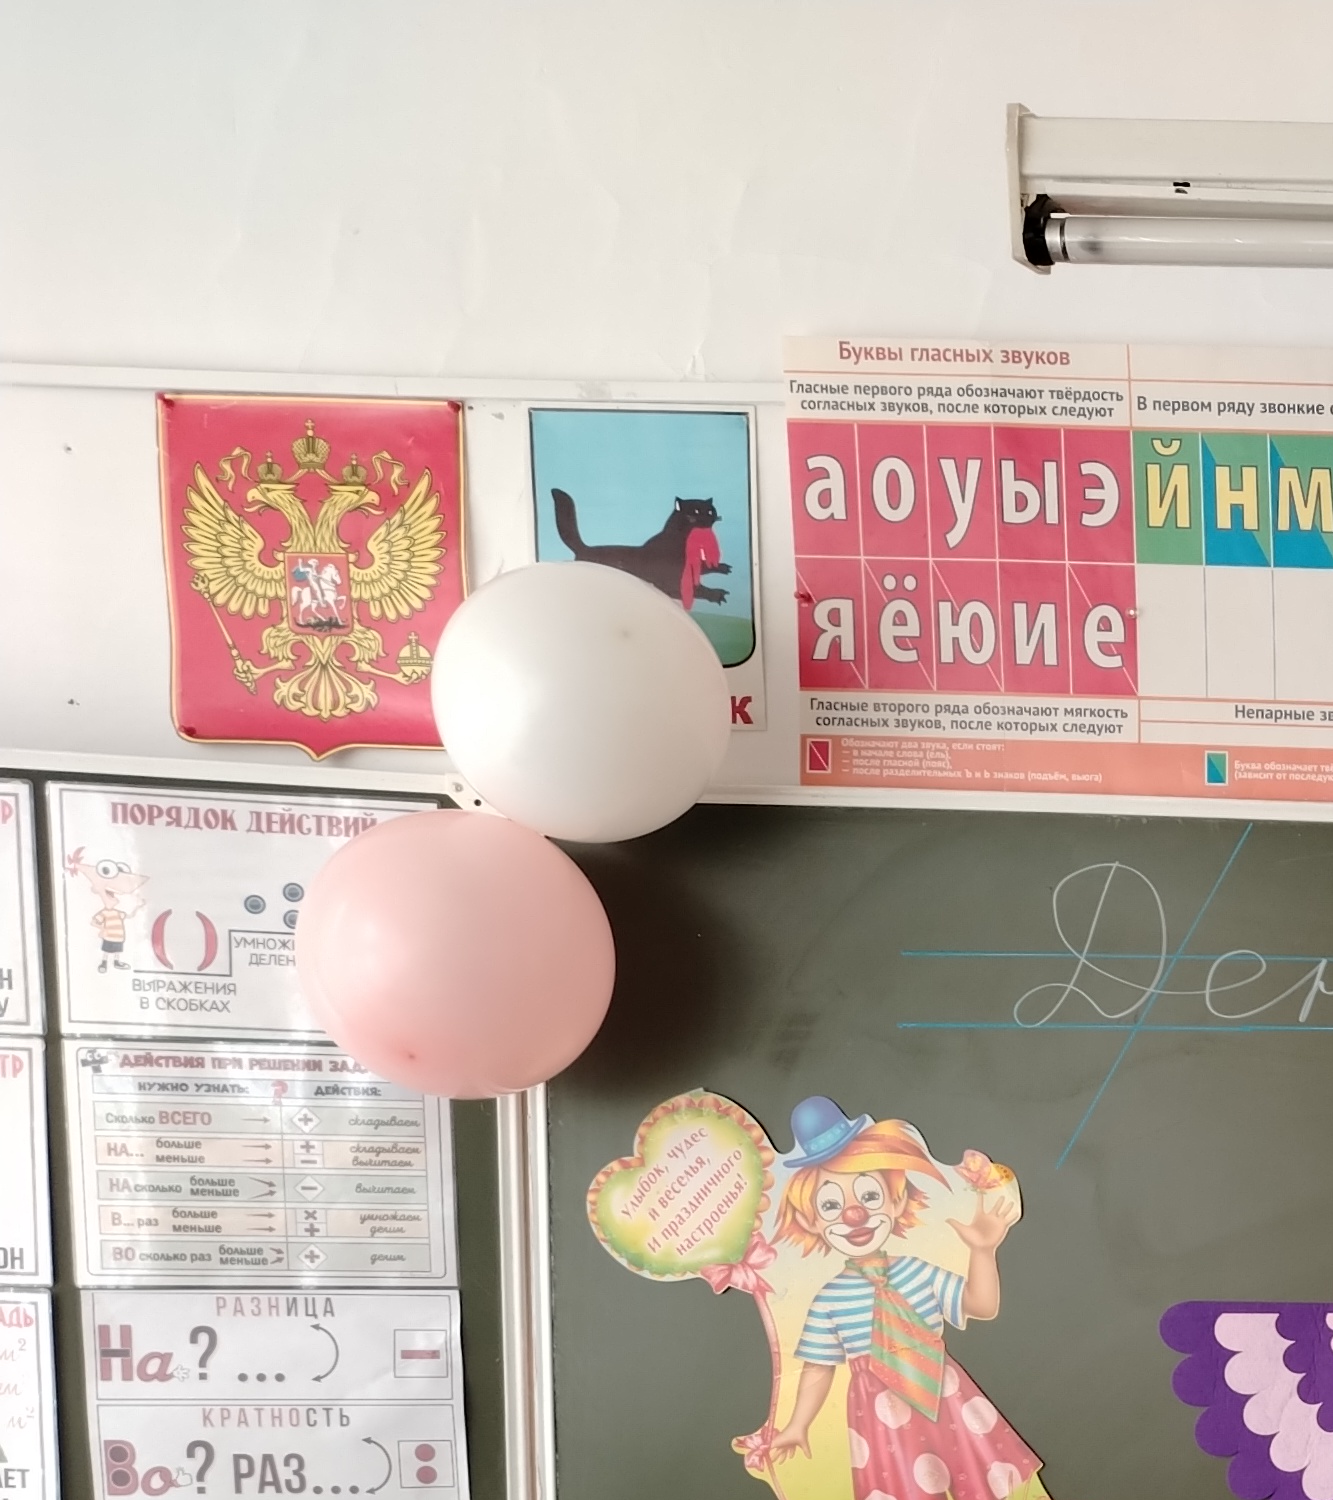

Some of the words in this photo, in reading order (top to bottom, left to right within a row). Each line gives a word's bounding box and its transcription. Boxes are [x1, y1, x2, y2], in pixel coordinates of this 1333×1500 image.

[838, 341, 903, 364] Буквы
[911, 347, 993, 363] гласных
[1001, 350, 1070, 368] звуков
[790, 381, 848, 395] Гласные
[854, 383, 912, 398] первого
[917, 386, 952, 399] ряда
[957, 384, 1043, 399] обозначают
[1049, 388, 1123, 403] твёрдость
[801, 401, 875, 412] согласных
[881, 402, 933, 415] звуков,
[937, 403, 979, 413] после
[984, 404, 1046, 417] которых
[1052, 405, 1114, 418] следуют
[1137, 396, 1147, 410] В
[1153, 400, 1211, 414] первом
[1218, 402, 1254, 416] ряду
[1260, 402, 1324, 415] звонкие
[810, 698, 868, 712] Гласные
[874, 702, 929, 716] второго
[935, 705, 969, 717] ряда
[974, 703, 1059, 718] обозначают
[1064, 707, 1127, 719] мягкость
[1235, 705, 1314, 723] Непарные
[816, 715, 889, 728] согласных
[895, 718, 946, 731] звуков,
[951, 719, 991, 731] после
[997, 720, 1057, 734] которых
[1062, 721, 1123, 736] следуют
[111, 802, 238, 831] ПОРЯДОК
[246, 807, 377, 838] ДЕЙСТВИЙ
[234, 936, 295, 951] УМНОЖ
[249, 954, 295, 966] ДЕЛЕН
[132, 979, 236, 996] ВЫРАЖЕНИЯ
[140, 998, 149, 1009] В
[155, 998, 230, 1013] СКОБКАХ
[120, 1054, 205, 1070] ДЕЙСТВИЯ
[211, 1056, 242, 1070] ПРИ
[249, 1057, 322, 1071] РЕШЕНИИ
[138, 1082, 188, 1092] НУЖНО
[195, 1083, 249, 1094] УЗНАТЬ:
[314, 1084, 381, 1097] ДЕЙСТВИЯ:
[105, 1113, 155, 1124] Сколько
[159, 1111, 211, 1125] ВСЕГО
[156, 1138, 202, 1149] больше
[667, 1128, 708, 1159] чудес
[156, 1154, 205, 1164] меньше
[109, 1178, 132, 1193] НА
[134, 1183, 182, 1193] сколько
[190, 1176, 235, 1187] больше
[190, 1187, 239, 1197] меньше
[648, 1208, 660, 1221] и
[658, 1156, 711, 1209] веселья,
[661, 1150, 742, 1240] праздничного
[138, 1217, 159, 1228] раз
[172, 1209, 217, 1219] больше
[676, 1173, 748, 1256] настроенья!
[172, 1223, 222, 1233] меньше
[112, 1248, 136, 1261] ВО
[139, 1251, 187, 1262] сколько
[191, 1252, 211, 1264] раз
[219, 1245, 263, 1256] больше
[220, 1255, 268, 1266] меньше
[216, 1296, 335, 1318] РАЗНИЦА
[203, 1408, 351, 1429] КРАТНОСТЬ
